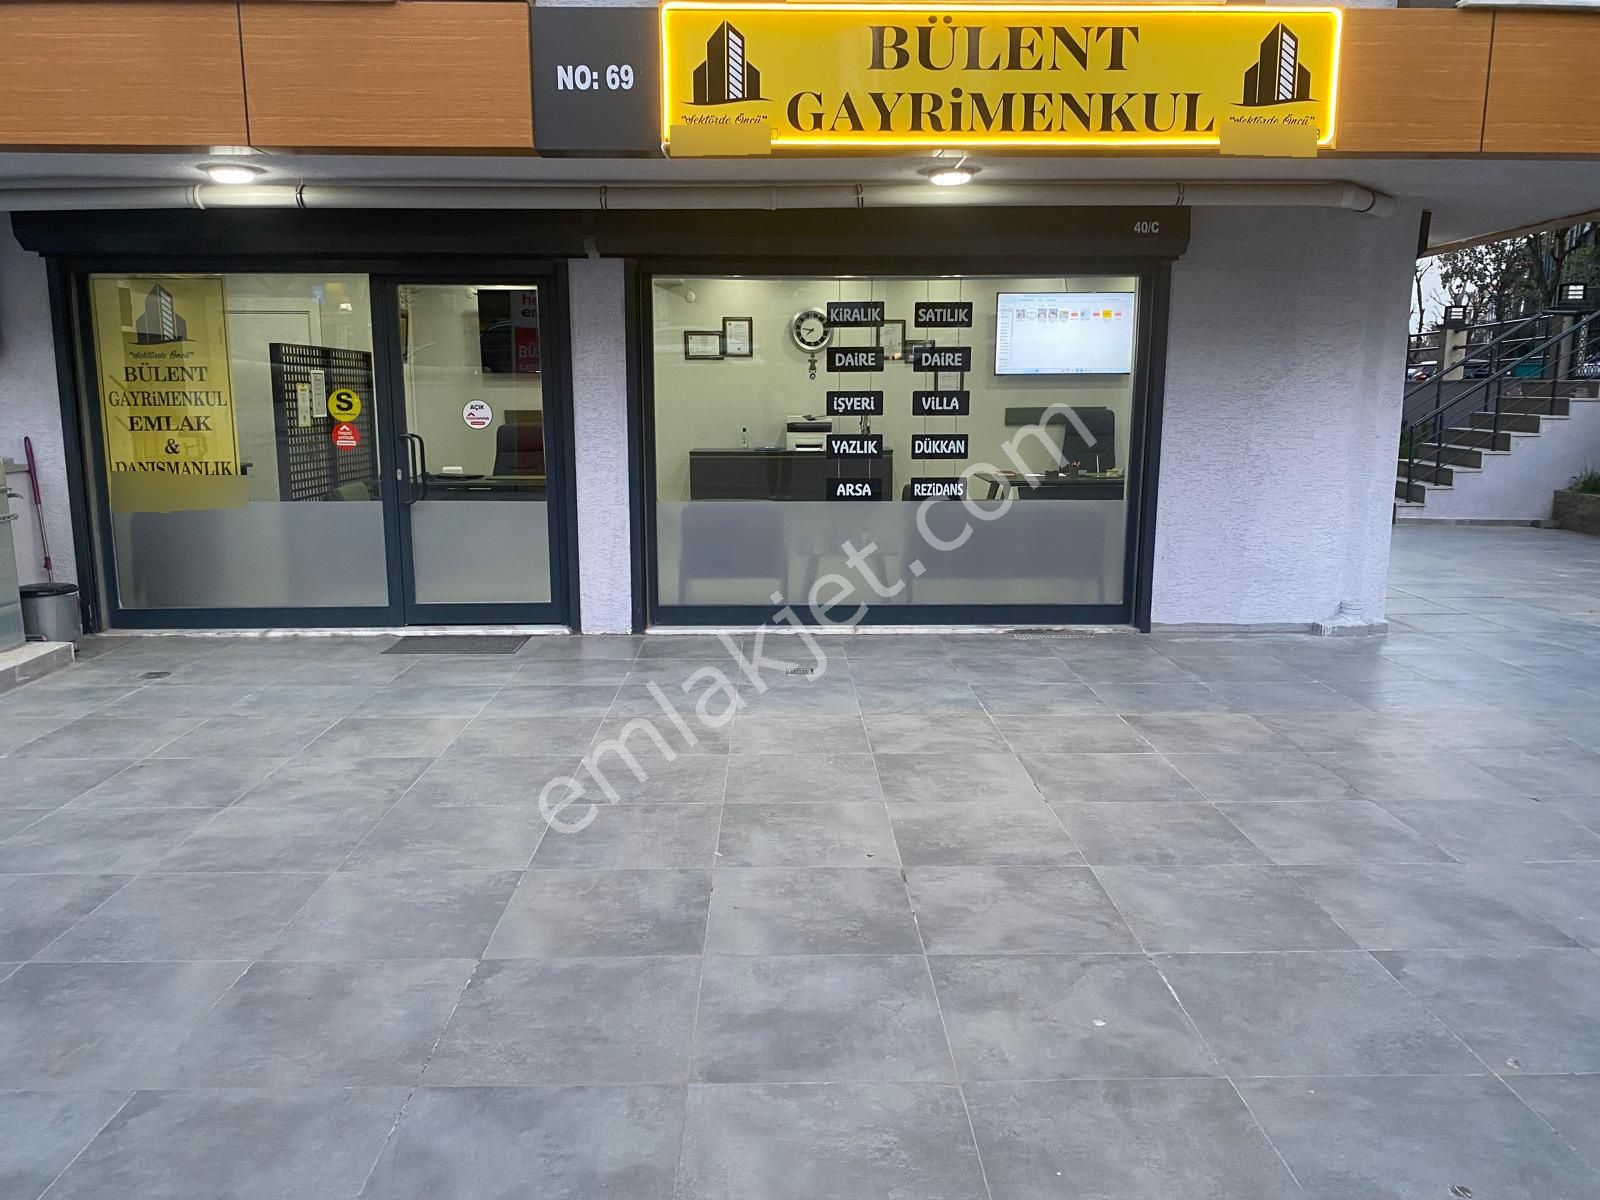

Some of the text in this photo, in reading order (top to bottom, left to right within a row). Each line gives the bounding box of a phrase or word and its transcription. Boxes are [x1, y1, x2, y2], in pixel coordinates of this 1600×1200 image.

[866, 16, 1139, 71] BÜLENT
[556, 64, 634, 90] NO: 69
[1133, 221, 1160, 234] 40/C
[918, 308, 969, 322] SATILIK
[124, 362, 208, 382] BÜLENT
[336, 392, 353, 411] S
[128, 415, 212, 431] EMLAK
[165, 438, 180, 454] &
[832, 440, 878, 454] YAZLIK
[914, 438, 965, 454] DÜKKAN
[836, 483, 872, 496] ARSA
